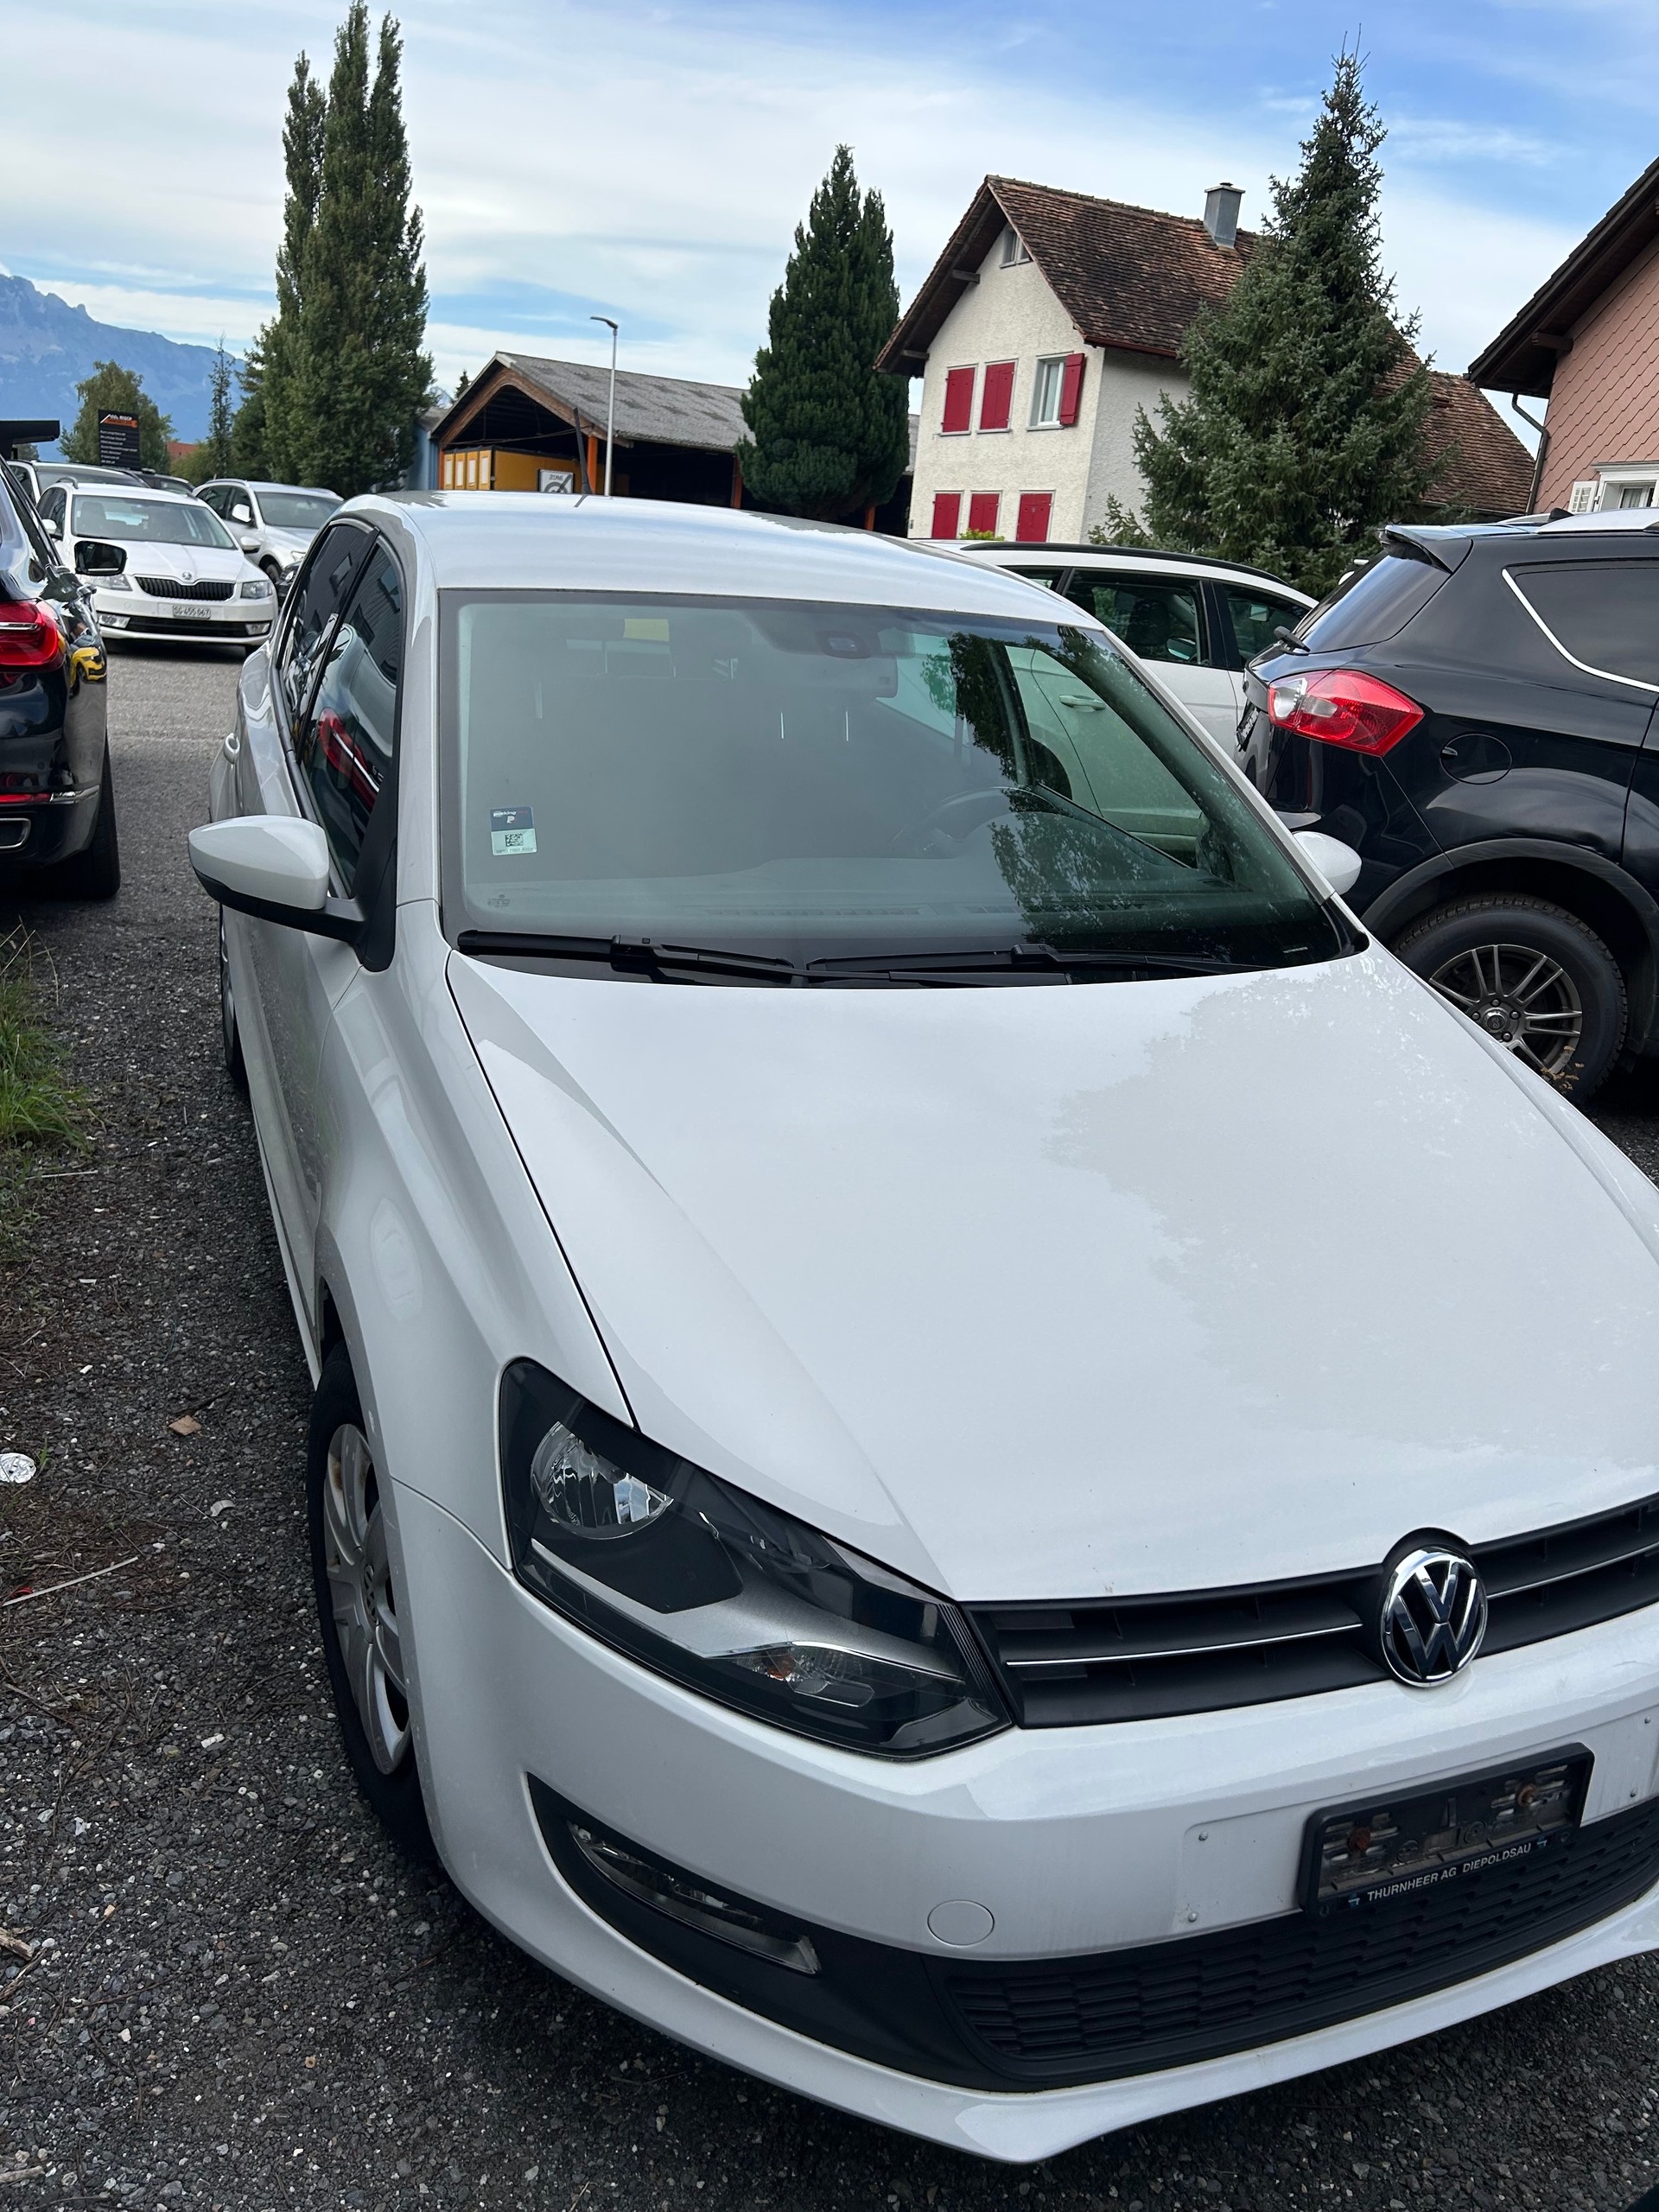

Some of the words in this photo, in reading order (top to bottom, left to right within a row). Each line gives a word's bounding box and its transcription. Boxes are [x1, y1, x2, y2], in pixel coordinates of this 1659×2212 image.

[1367, 1872, 1439, 1902] THURNHEER
[1440, 1867, 1457, 1880] AG
[1462, 1843, 1532, 1873] DIEPOLDSAU
